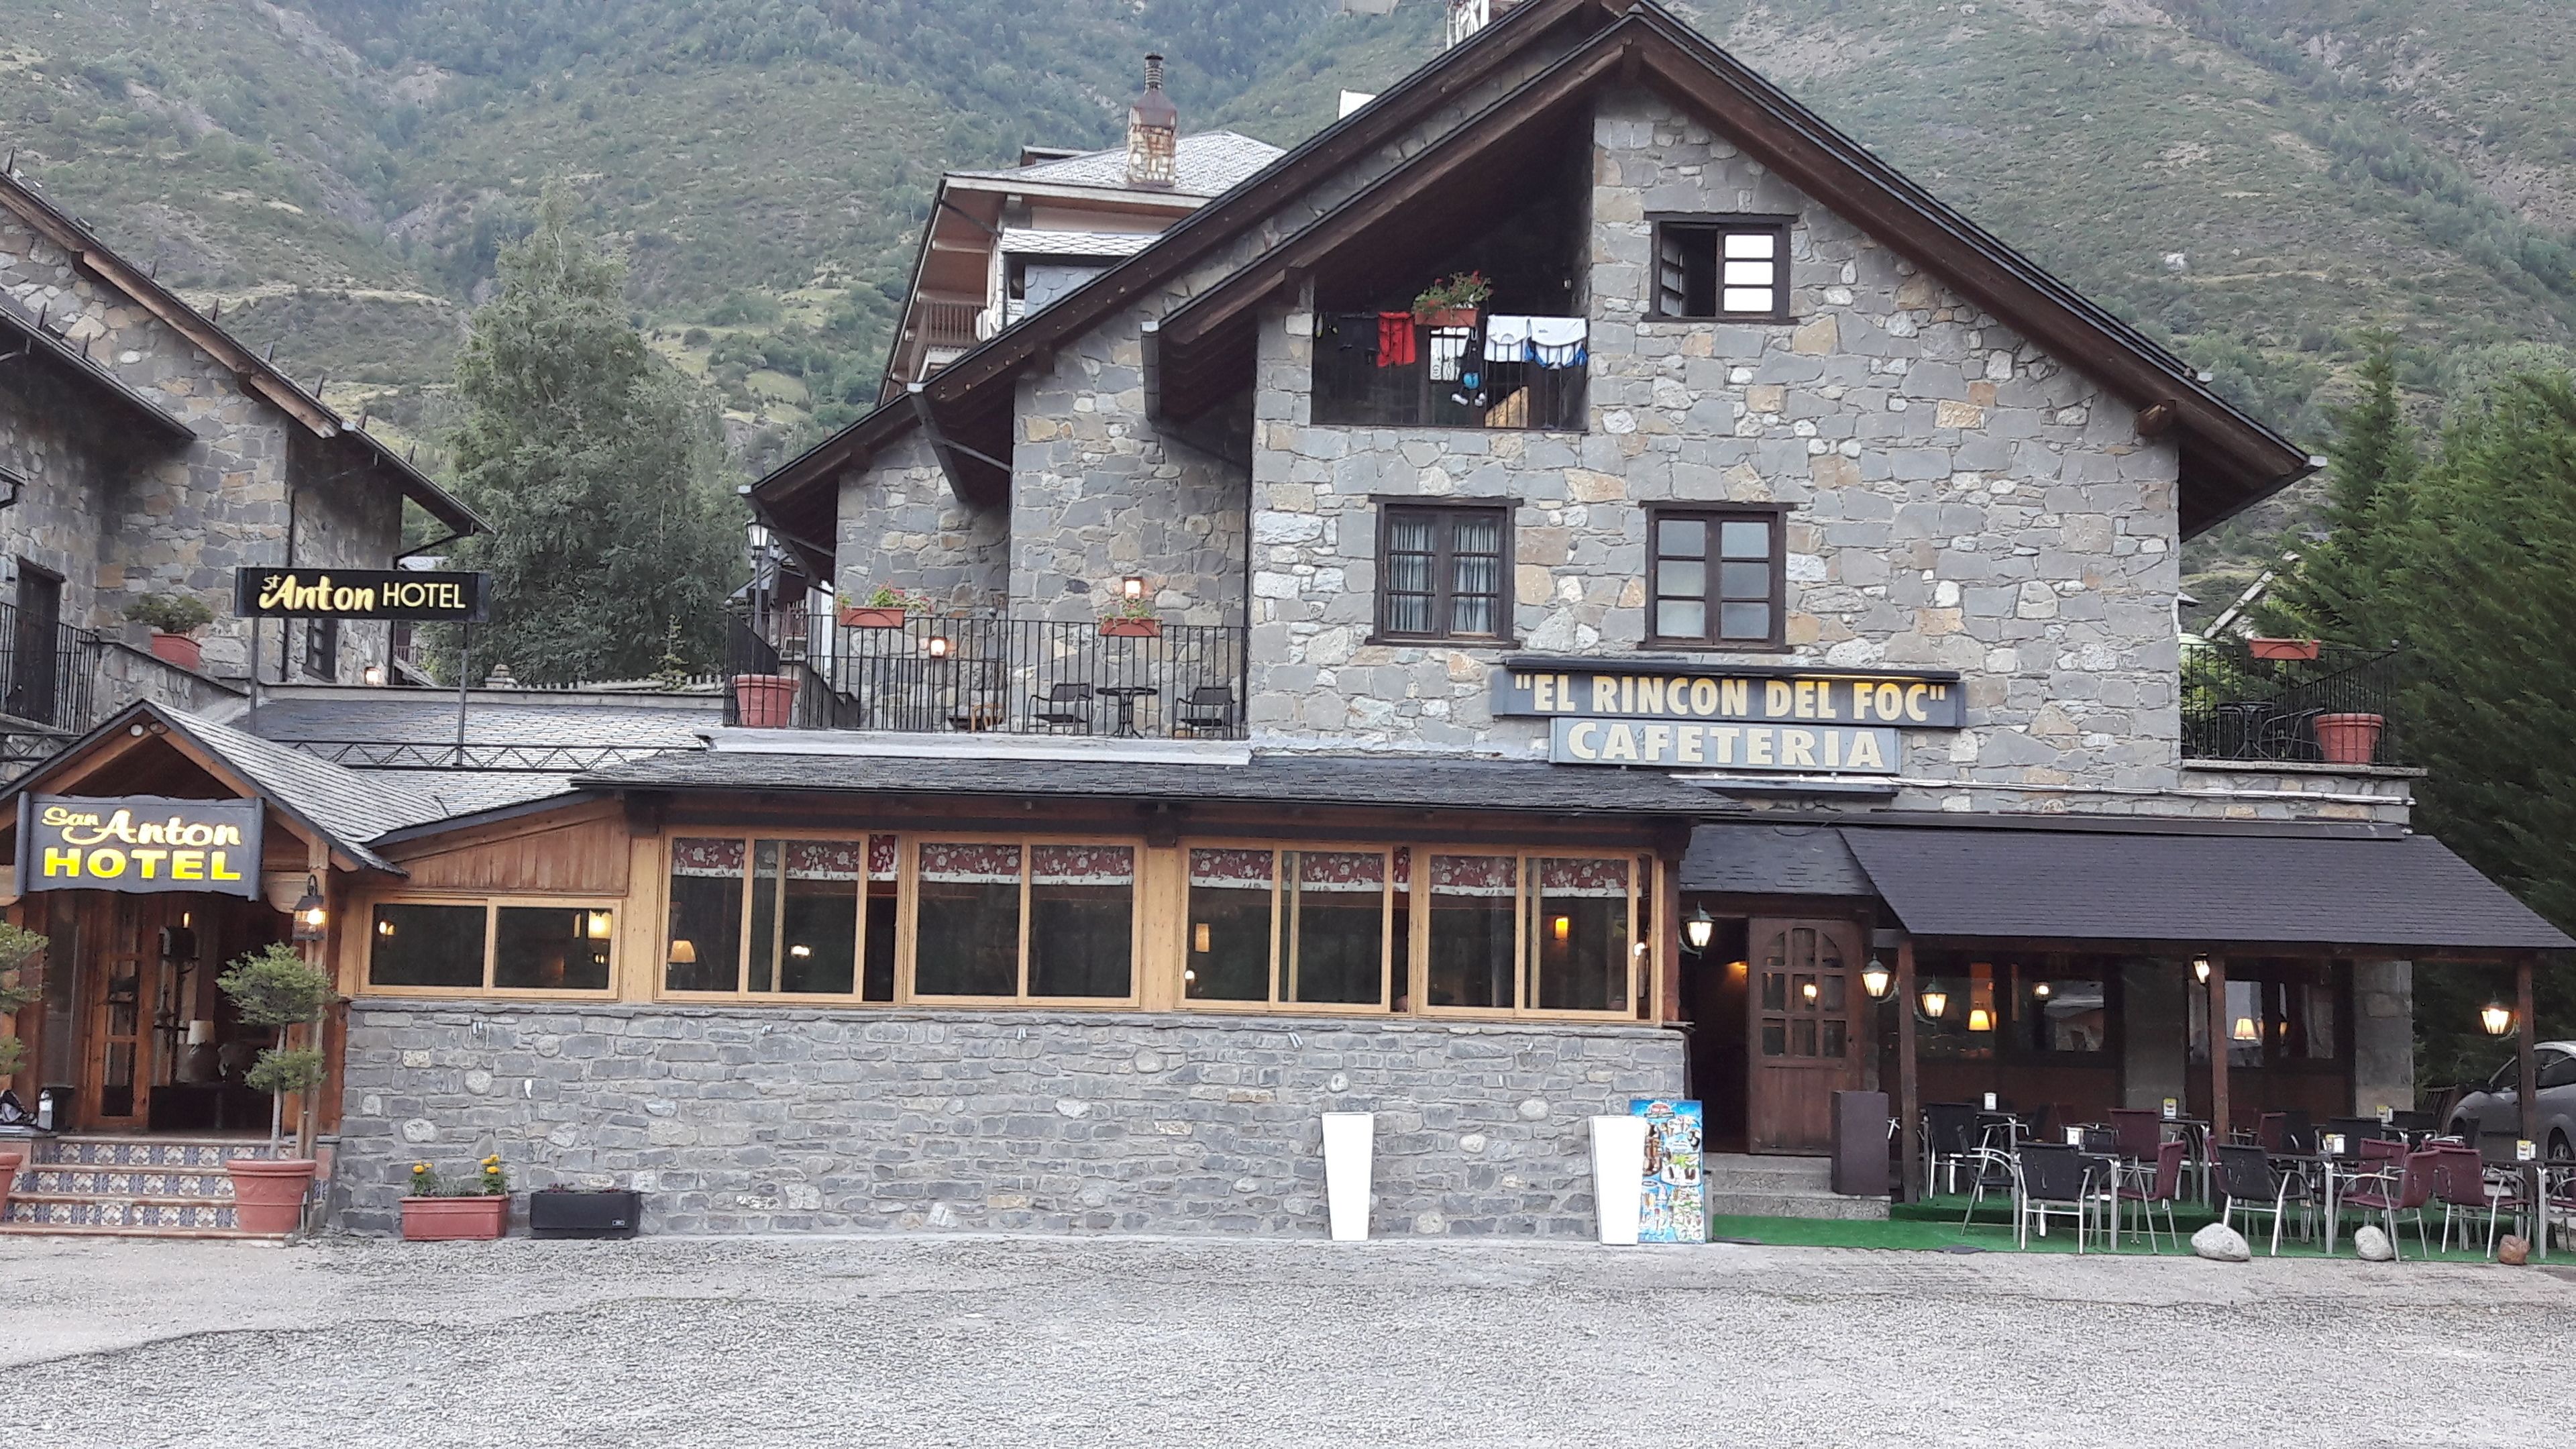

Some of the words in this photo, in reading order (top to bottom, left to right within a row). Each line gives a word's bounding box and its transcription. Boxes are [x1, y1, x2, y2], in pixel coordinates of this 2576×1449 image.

[258, 574, 376, 611] Anton
[383, 582, 466, 608] HOTEL
[1514, 674, 1576, 712] "EL
[1592, 676, 1748, 716] RINCON
[1765, 680, 1836, 719] DEL
[1853, 682, 1945, 722] FOC"
[1567, 721, 1884, 769] CAFETERIA
[42, 806, 99, 826] San
[62, 809, 241, 846] Anton
[44, 847, 241, 881] HOTEL
